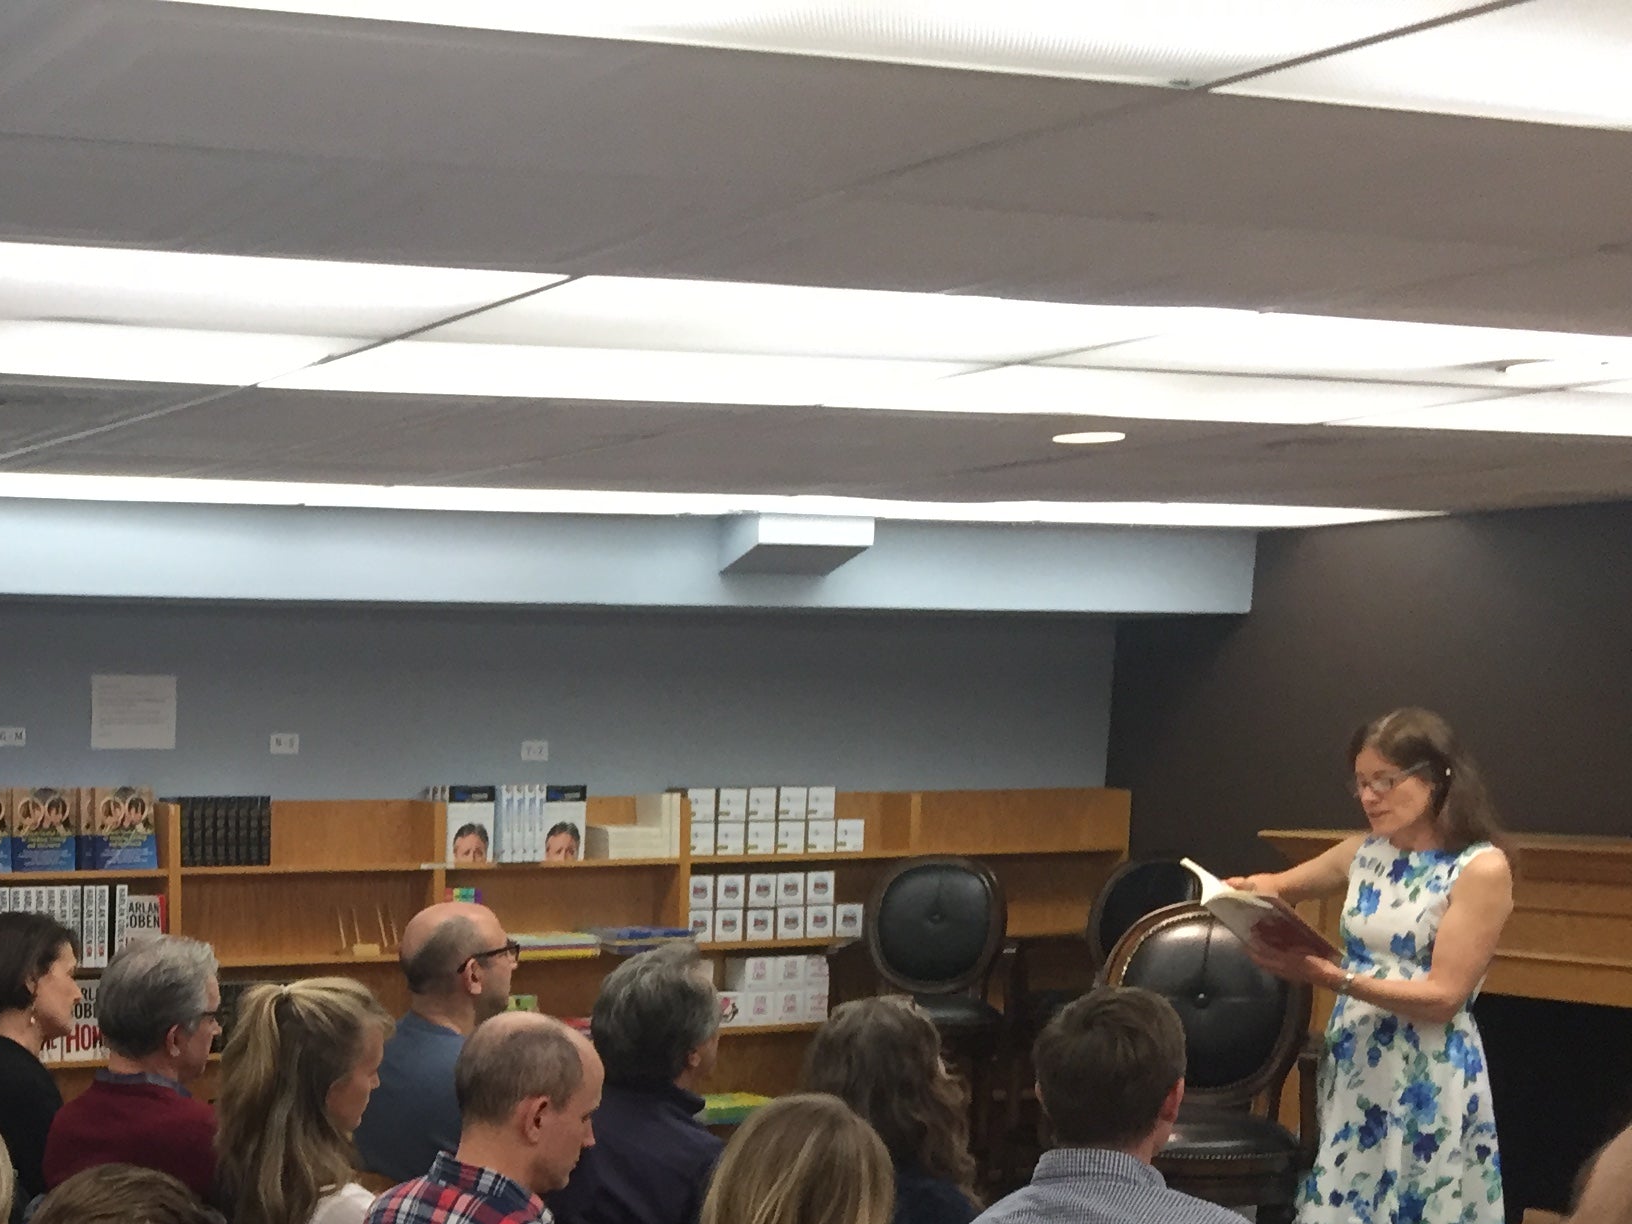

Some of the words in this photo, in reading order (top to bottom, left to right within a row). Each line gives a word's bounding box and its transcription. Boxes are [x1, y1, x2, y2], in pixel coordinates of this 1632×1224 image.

[128, 901, 159, 914] ARLAN
[126, 914, 160, 928] OBEN
[66, 1023, 103, 1053] HOM
